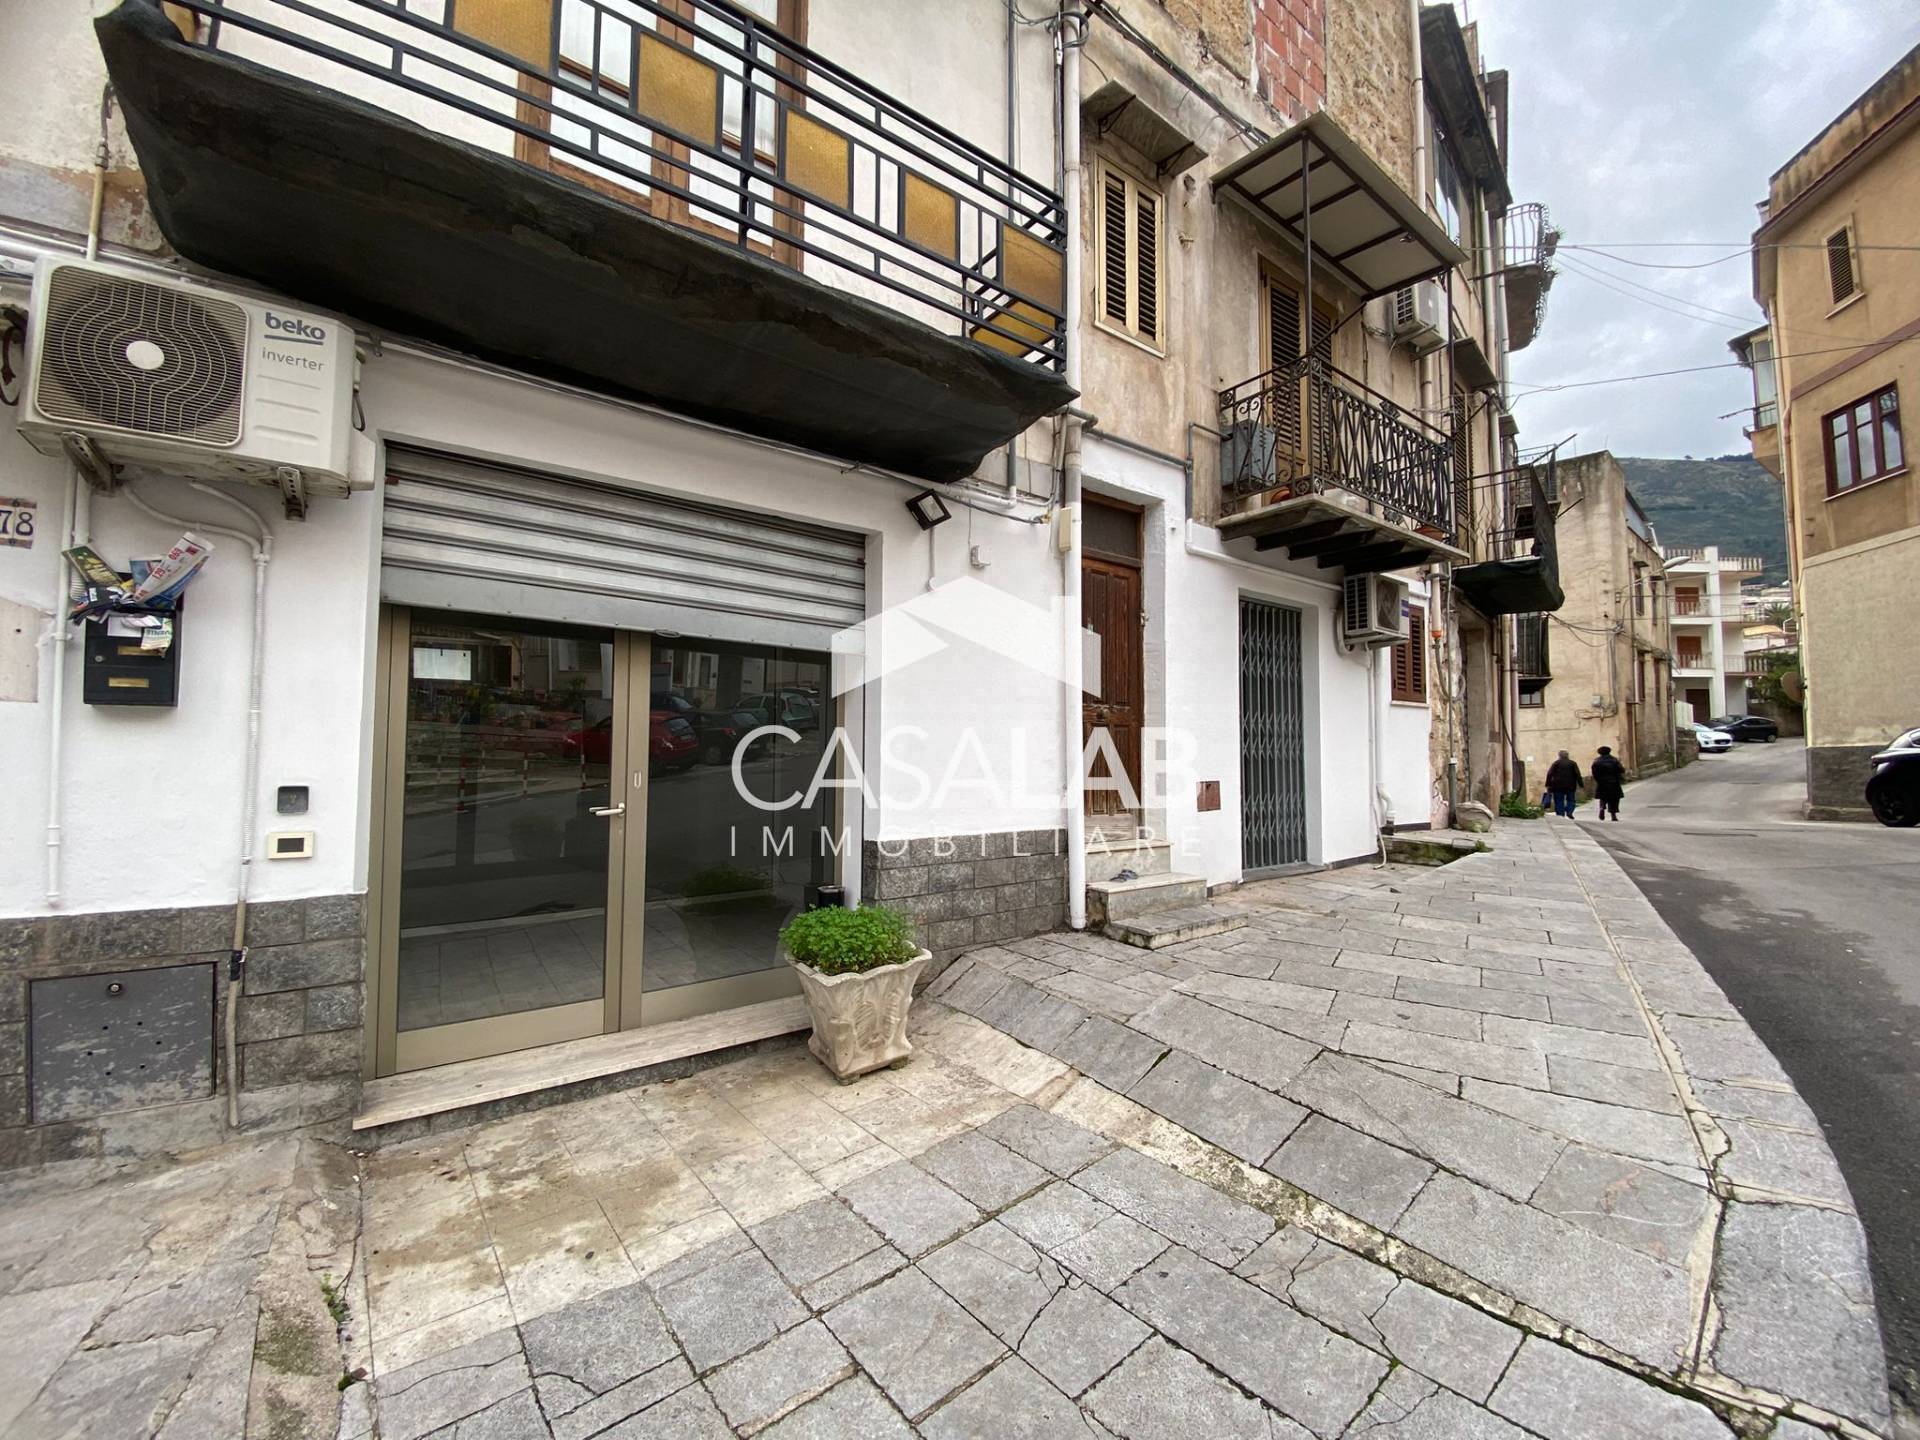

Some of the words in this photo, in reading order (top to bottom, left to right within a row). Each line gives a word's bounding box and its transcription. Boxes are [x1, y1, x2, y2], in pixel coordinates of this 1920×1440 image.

[265, 312, 326, 340] beko
[262, 347, 325, 371] inverter
[0, 510, 34, 536] 78
